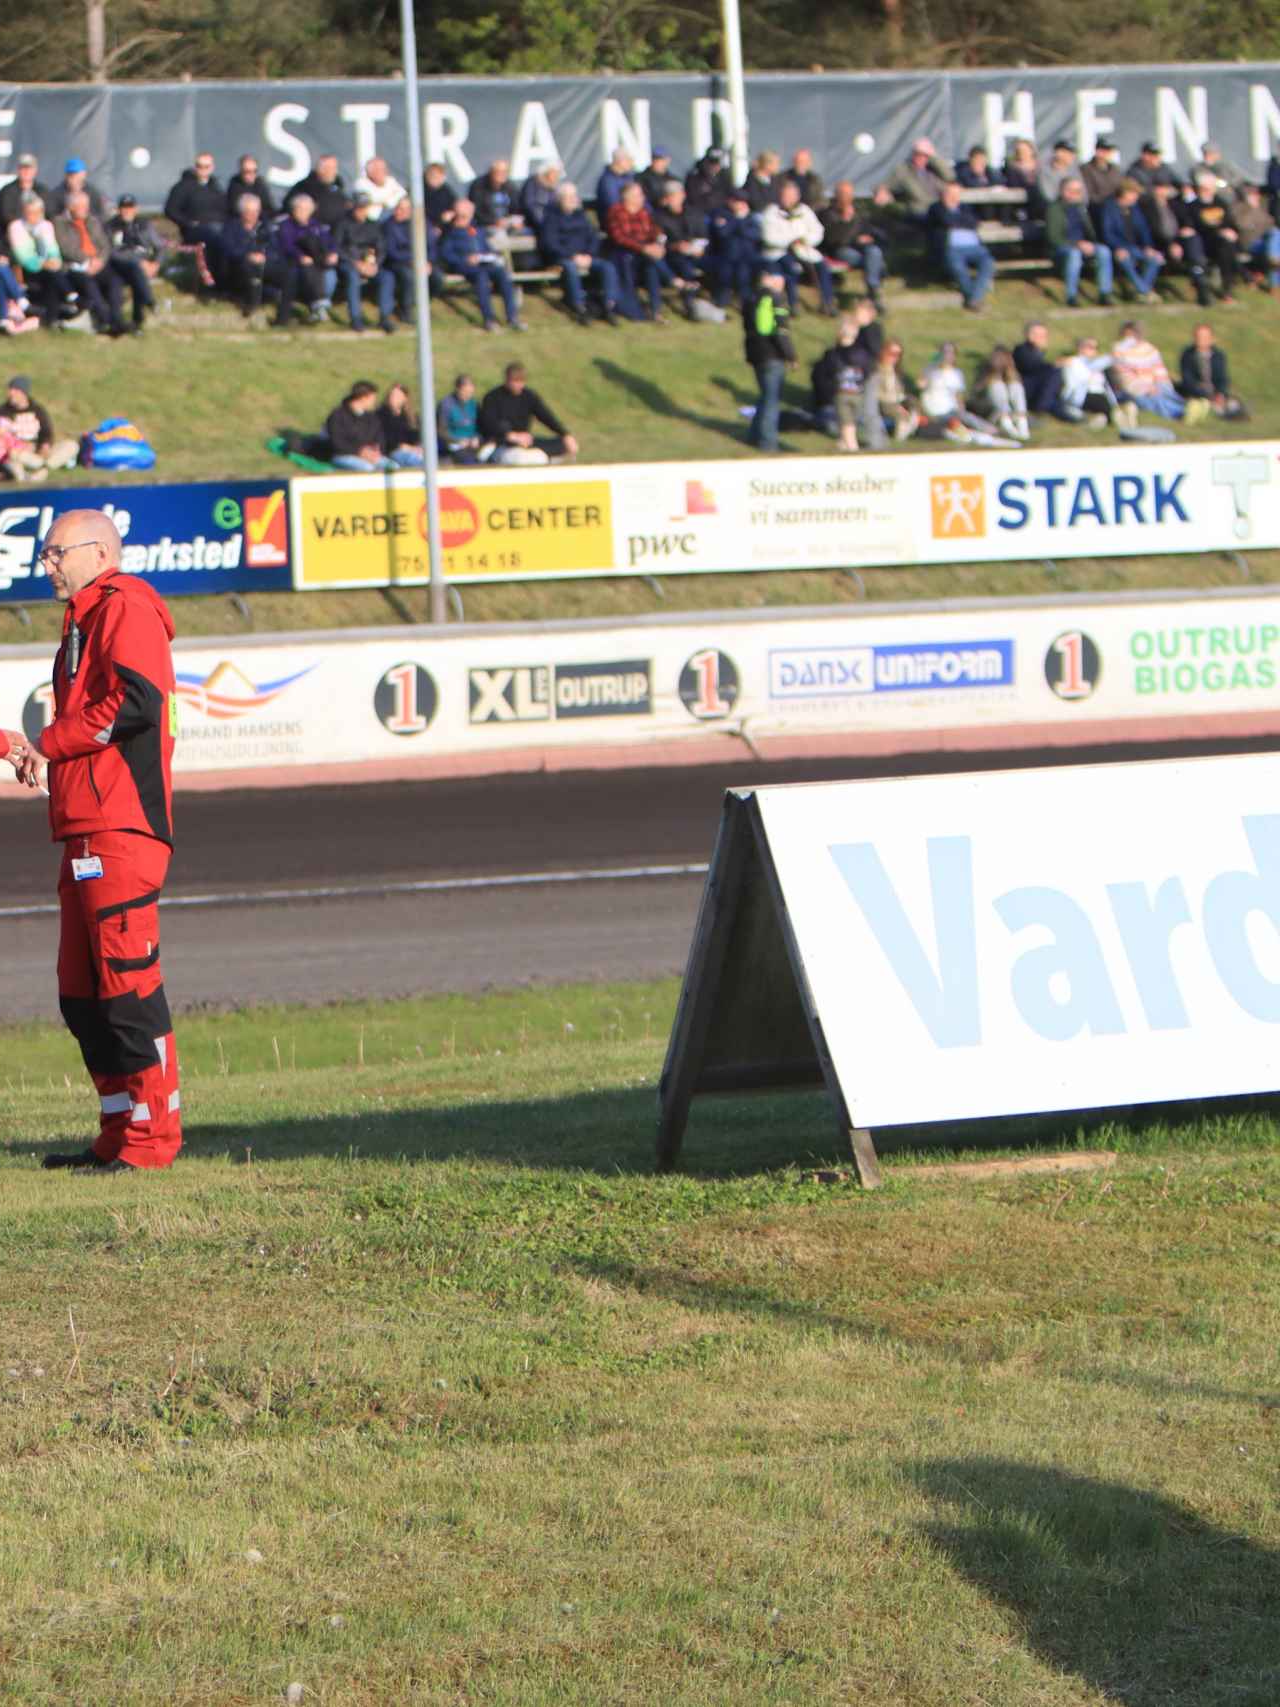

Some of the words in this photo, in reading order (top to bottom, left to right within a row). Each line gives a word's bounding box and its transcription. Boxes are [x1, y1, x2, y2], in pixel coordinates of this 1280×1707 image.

[824, 473, 897, 494] skaber
[997, 472, 1190, 531] STARK
[313, 513, 409, 538] VARDE
[487, 505, 602, 532] CENTER
[775, 504, 867, 525] sammen
[628, 532, 697, 565] pwc
[1129, 624, 1280, 660] OUTRUP
[690, 652, 732, 717] 1
[1054, 633, 1093, 698] 1
[1135, 658, 1277, 696] BIOGAS
[387, 664, 427, 733] 1
[471, 668, 549, 723] XL
[558, 674, 649, 708] OUTRUP
[827, 813, 1280, 1049] Vard
